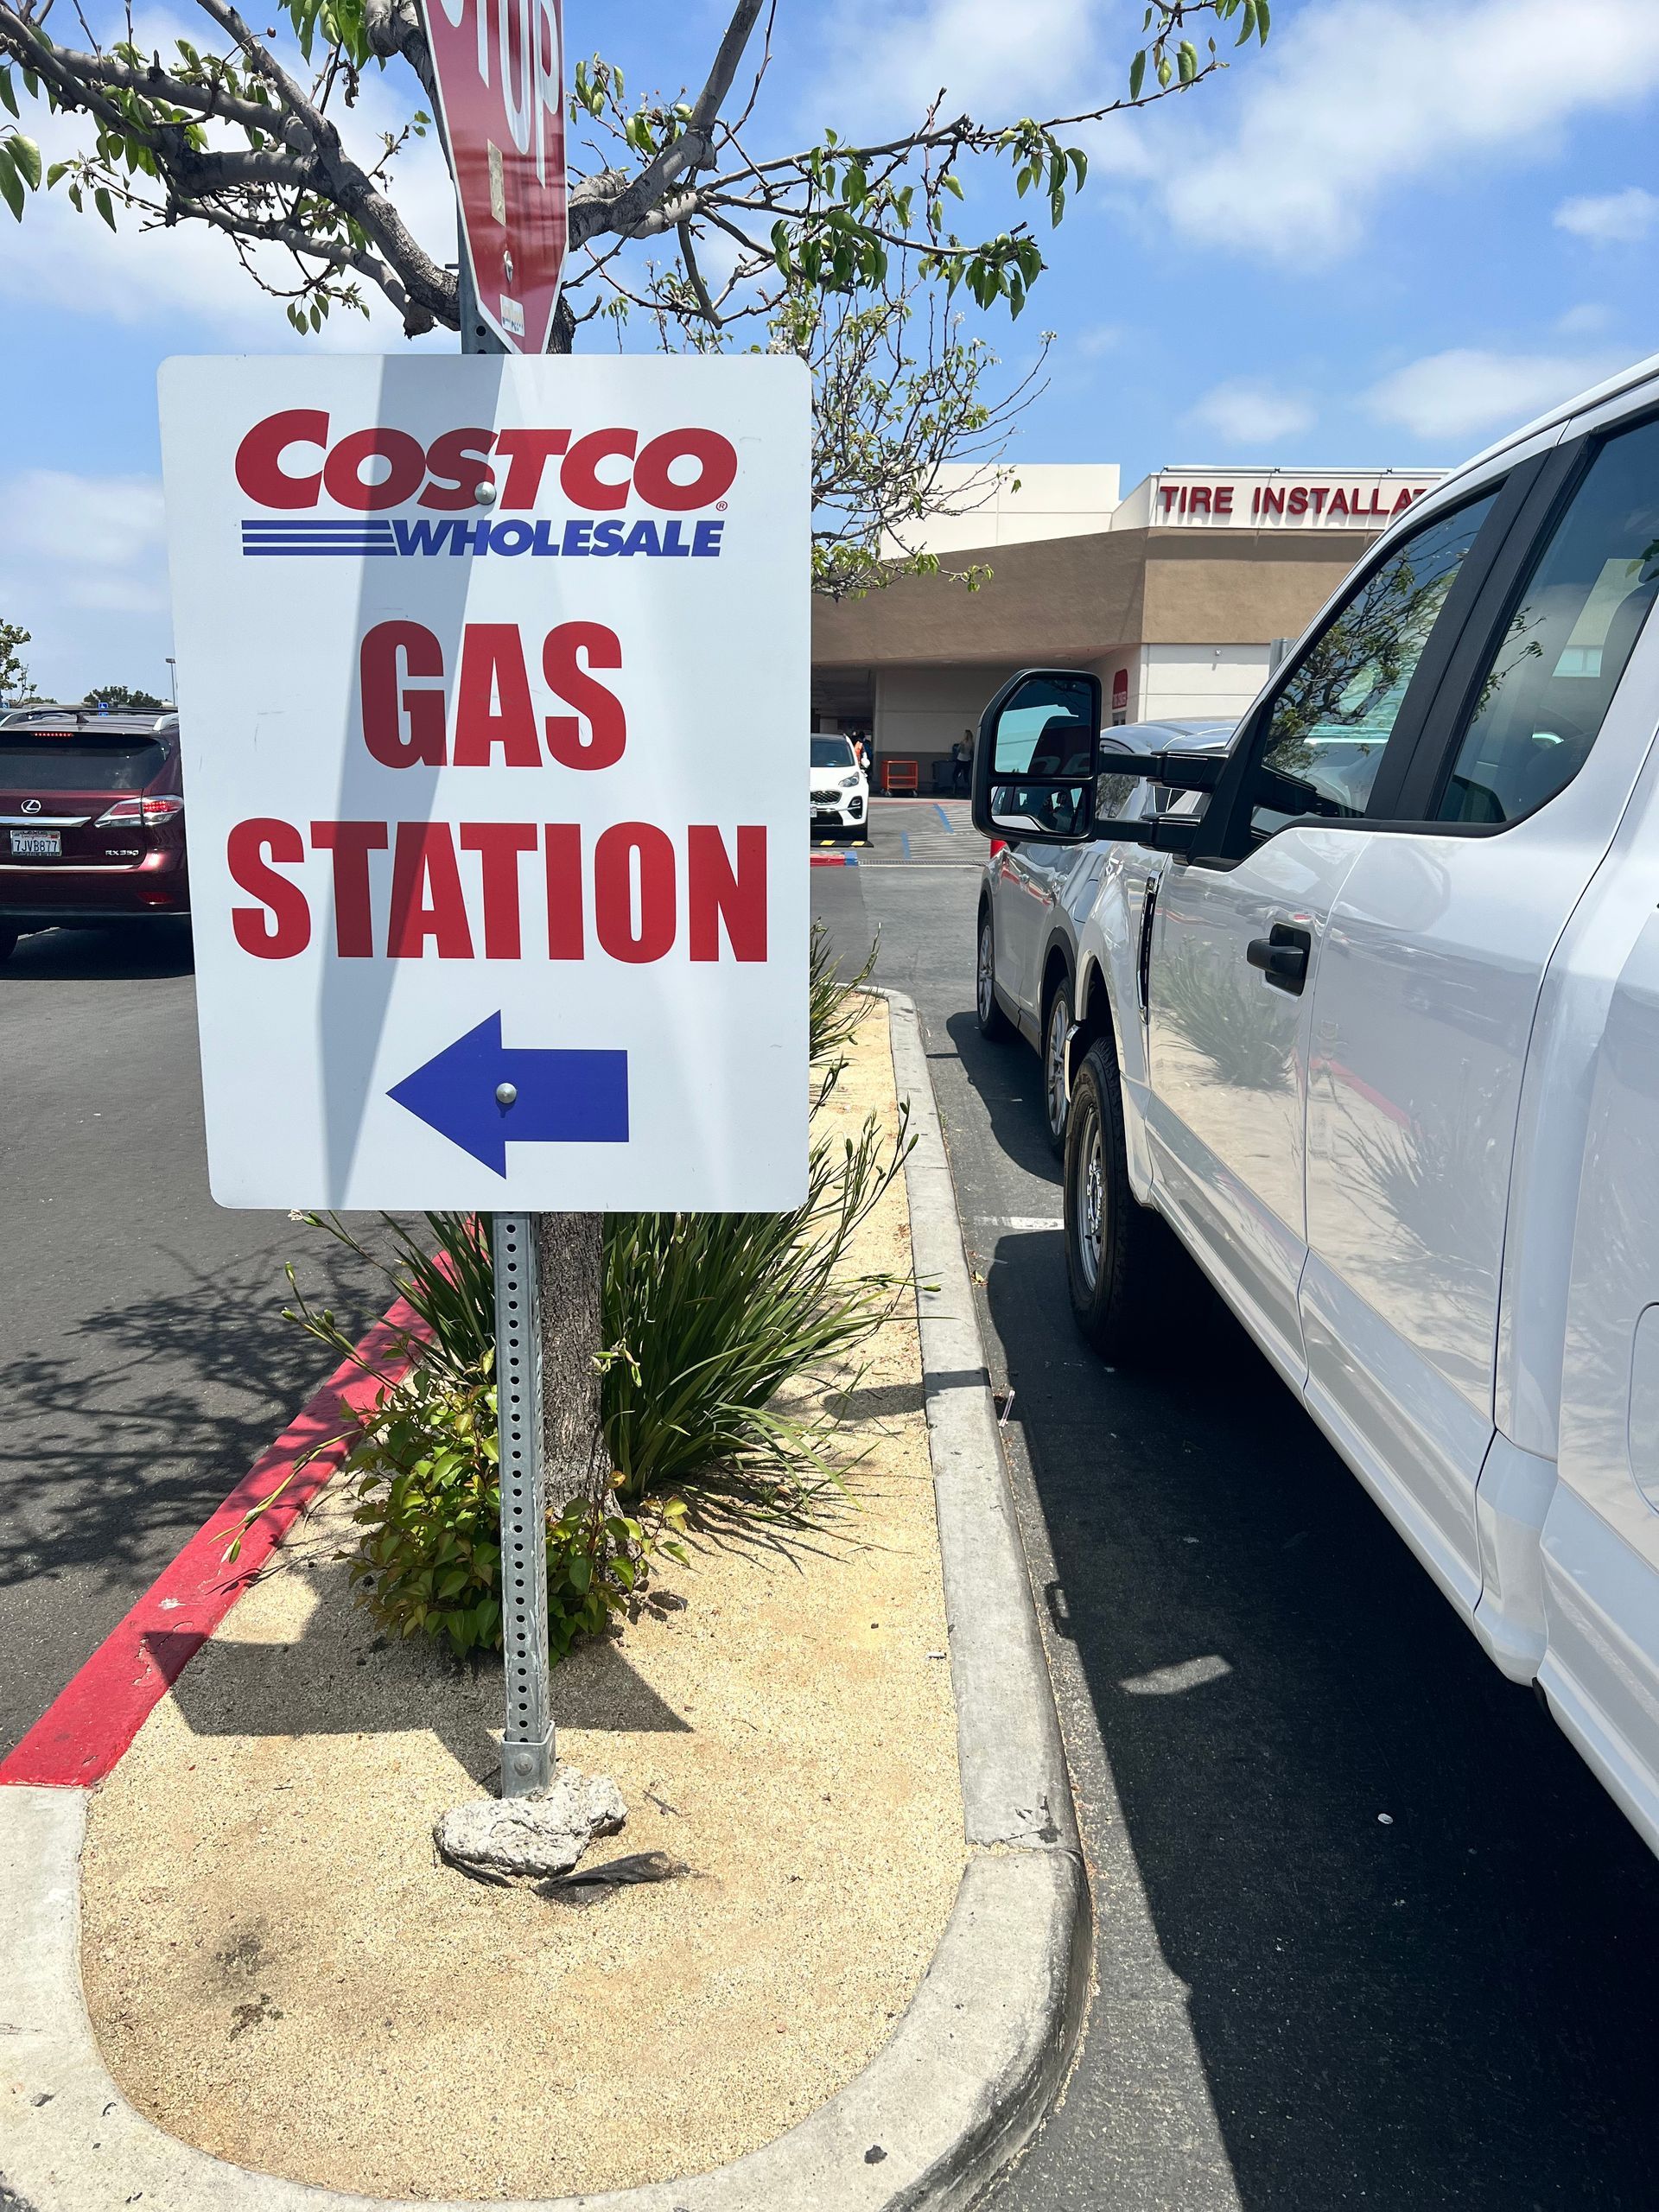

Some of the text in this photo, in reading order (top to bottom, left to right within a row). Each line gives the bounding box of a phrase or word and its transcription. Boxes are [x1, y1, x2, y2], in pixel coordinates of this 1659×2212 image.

[234, 409, 737, 512] COSTCO
[1160, 486, 1235, 513] TIRE
[391, 519, 724, 556] WHOLESALE
[359, 620, 627, 771] GAS
[14, 839, 58, 852] 7JVB877
[226, 817, 768, 964] STATION
